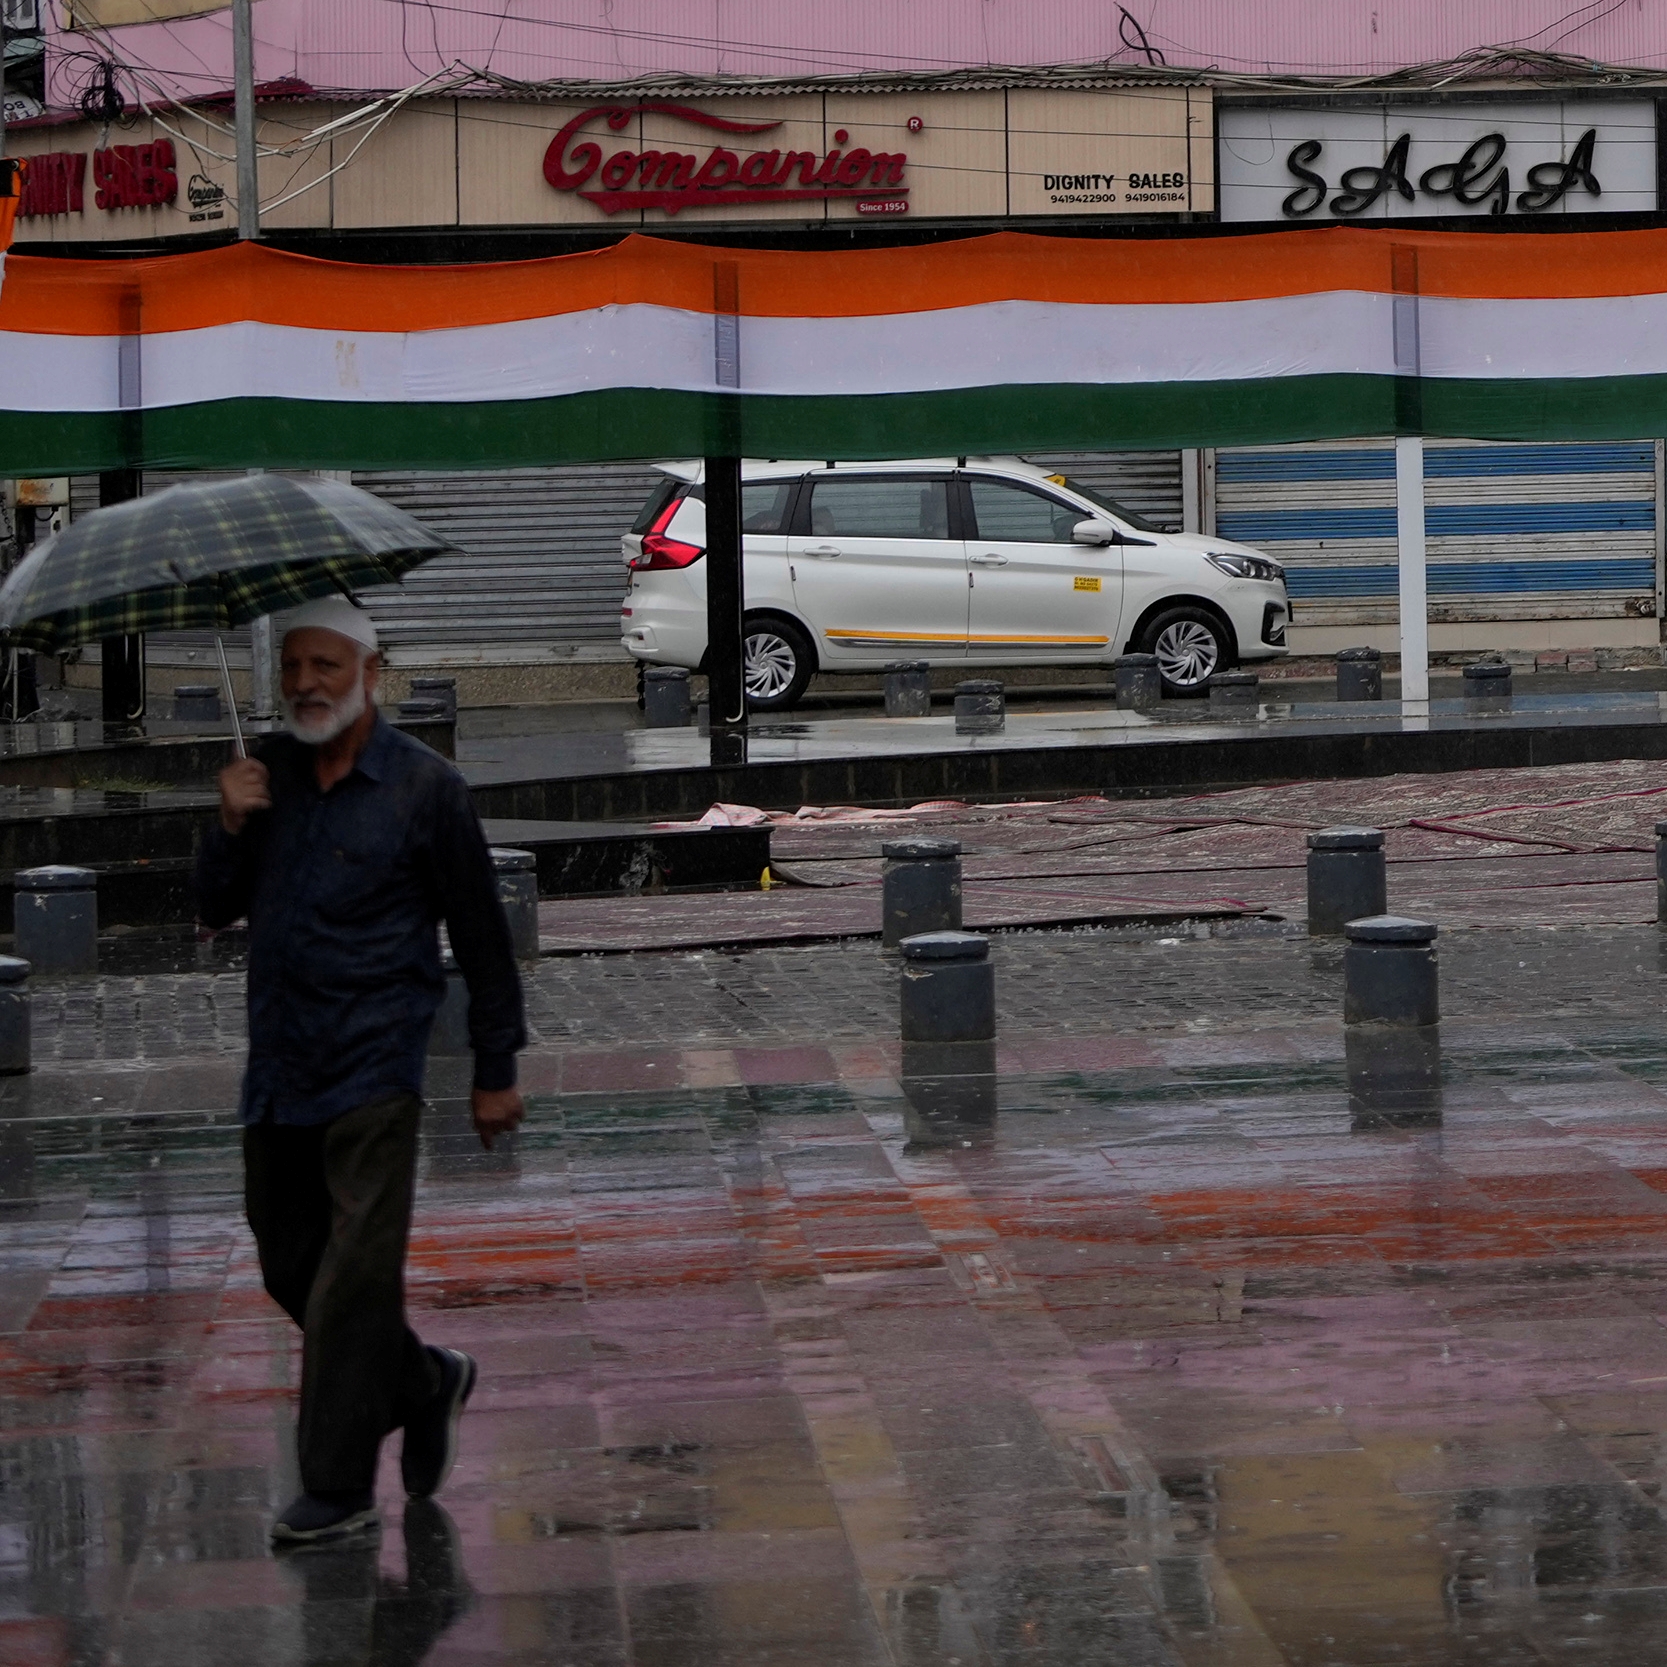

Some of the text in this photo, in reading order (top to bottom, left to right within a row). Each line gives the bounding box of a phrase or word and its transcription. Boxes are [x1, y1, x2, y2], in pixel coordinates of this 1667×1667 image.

[94, 138, 178, 210] SALES
[542, 104, 909, 210] Companion
[1282, 128, 1602, 216] SAGA
[1044, 172, 1185, 190] DIGNITY SALES
[1050, 193, 1185, 203] 9419422900 9419016184
[860, 201, 906, 212] Since 1954
